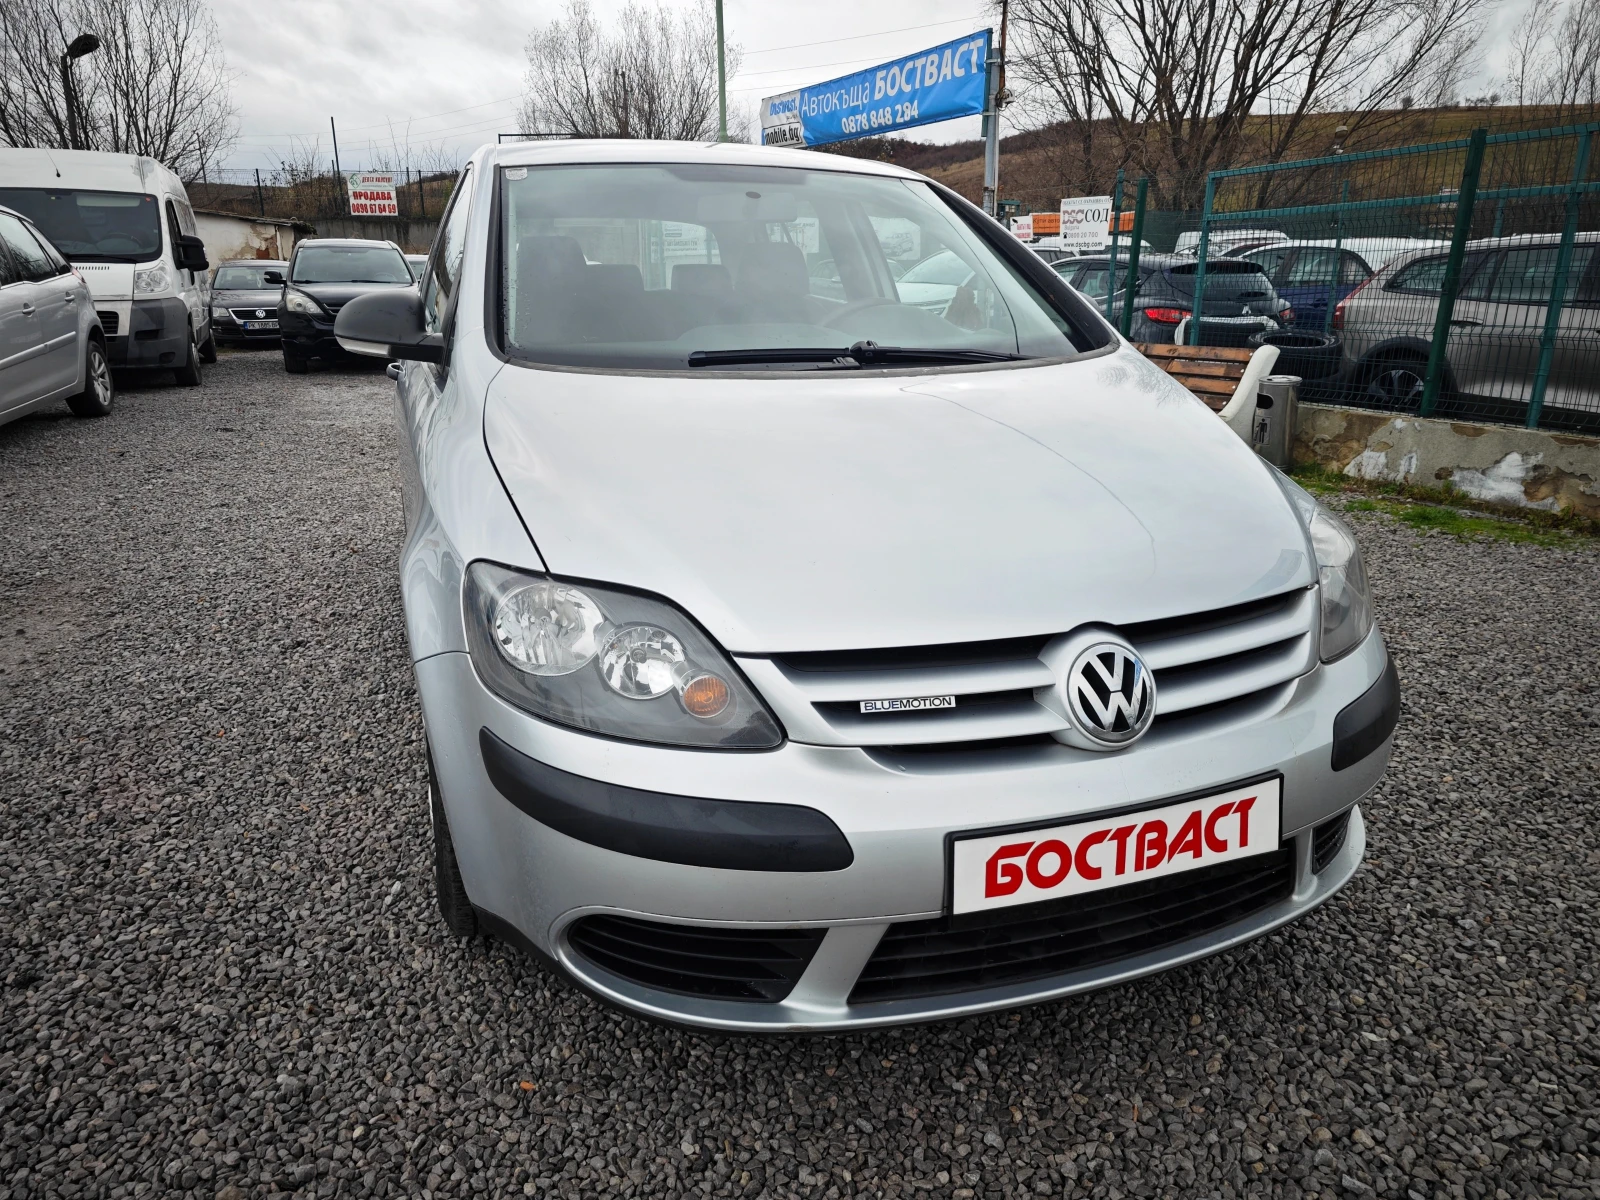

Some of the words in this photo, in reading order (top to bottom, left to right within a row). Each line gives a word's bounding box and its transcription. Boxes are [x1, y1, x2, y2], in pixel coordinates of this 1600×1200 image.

[801, 82, 870, 118] Автокъща
[873, 38, 984, 101] БОСТВАСТ
[841, 112, 869, 134] 0878
[870, 108, 892, 127] 848
[894, 100, 919, 123] 284
[352, 191, 393, 201] ПРОДАВА
[352, 203, 369, 214] 0898
[369, 203, 377, 214] 67
[378, 203, 387, 214] 64
[388, 203, 396, 214] 69
[1062, 209, 1085, 225] DSC
[1085, 208, 1109, 223] СОД
[1064, 241, 1103, 249] www.dscbg.com
[864, 696, 952, 711] BLUEMOTION
[984, 796, 1258, 899] БОСТВАСТ
